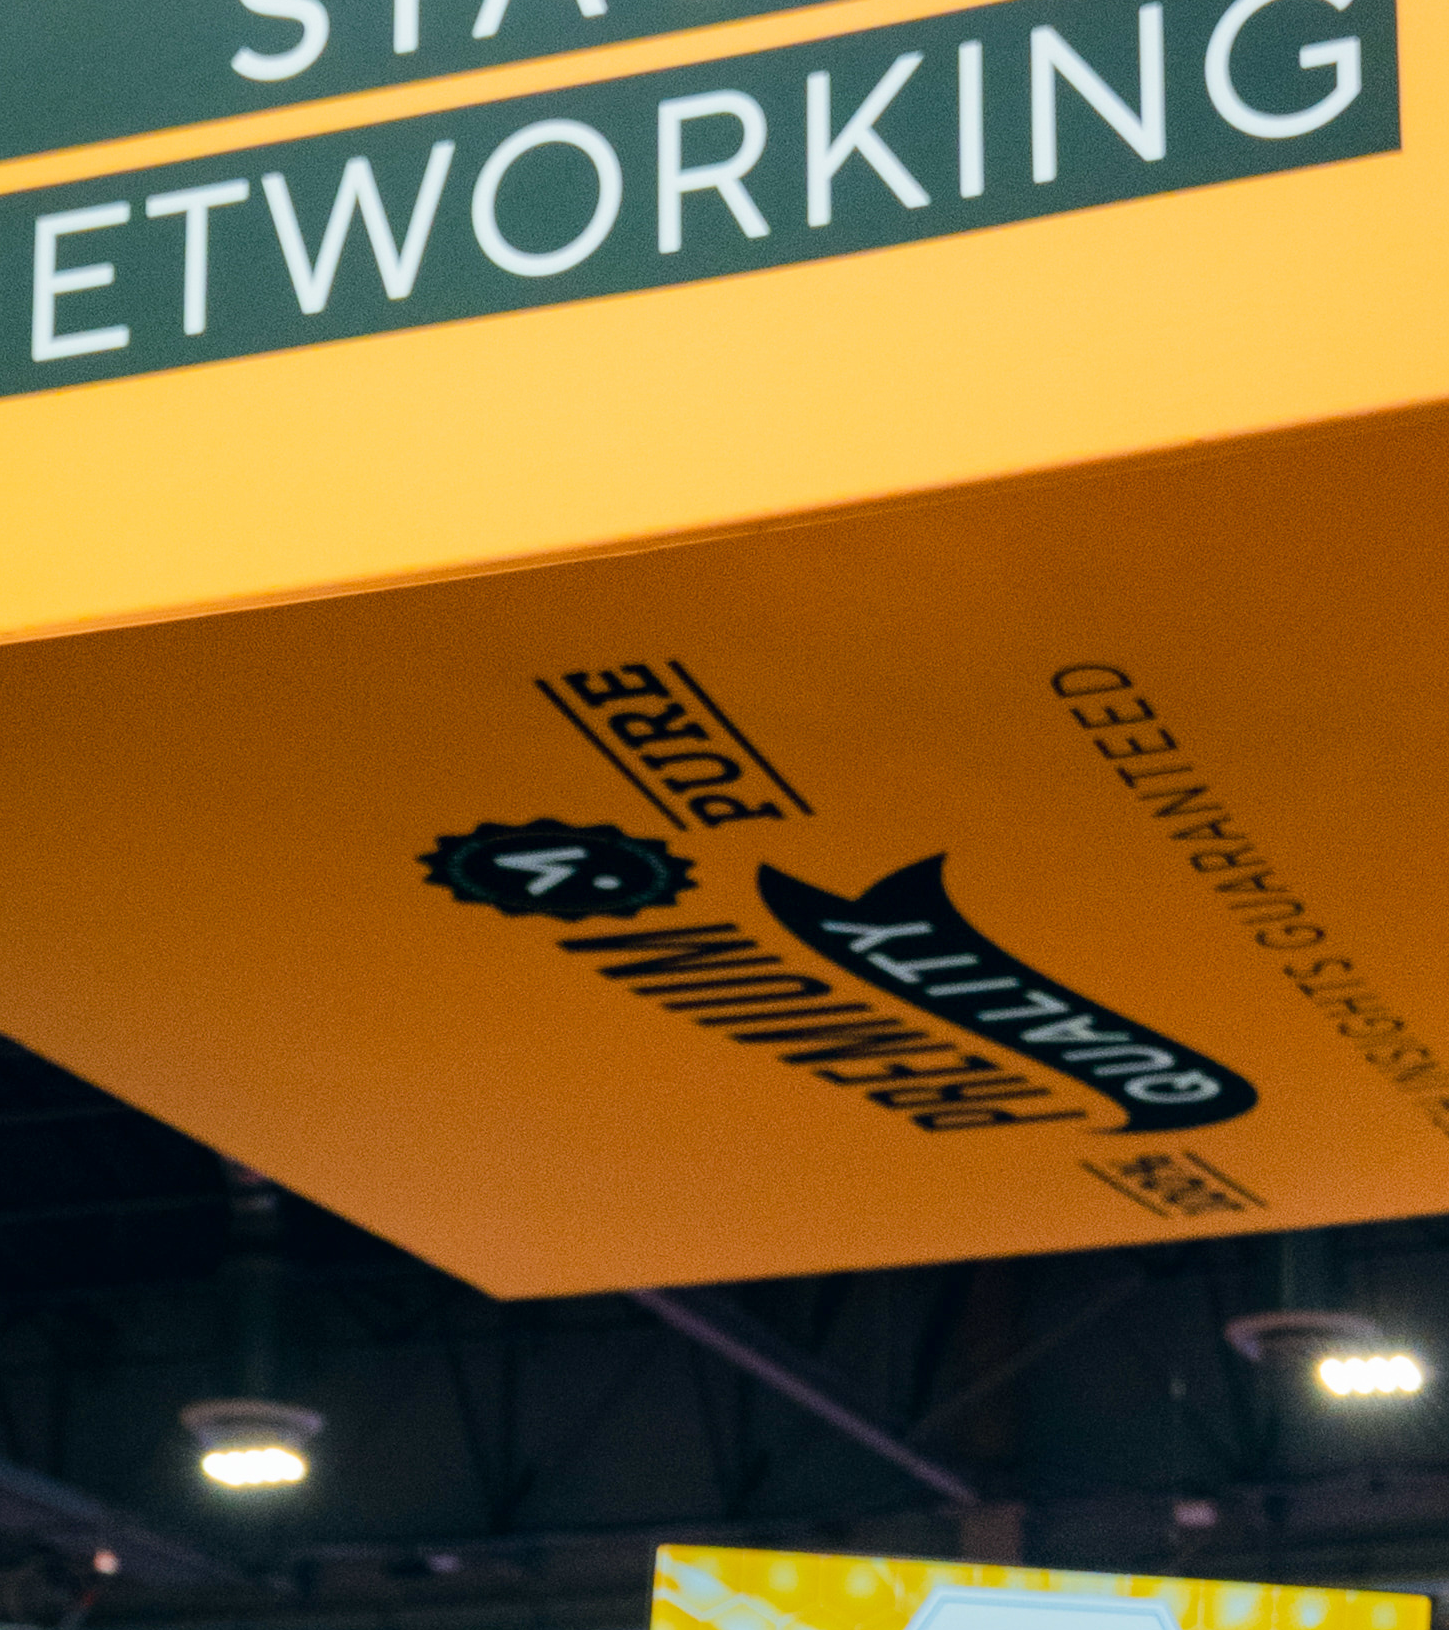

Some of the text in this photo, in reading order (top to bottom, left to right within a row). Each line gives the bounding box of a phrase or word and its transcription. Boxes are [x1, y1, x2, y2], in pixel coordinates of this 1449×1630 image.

[563, 662, 786, 831] PURE
[1051, 660, 1327, 952] GUARANTEED
[557, 922, 1086, 1133] PREMIUM
[821, 918, 1222, 1105] QUALITY
